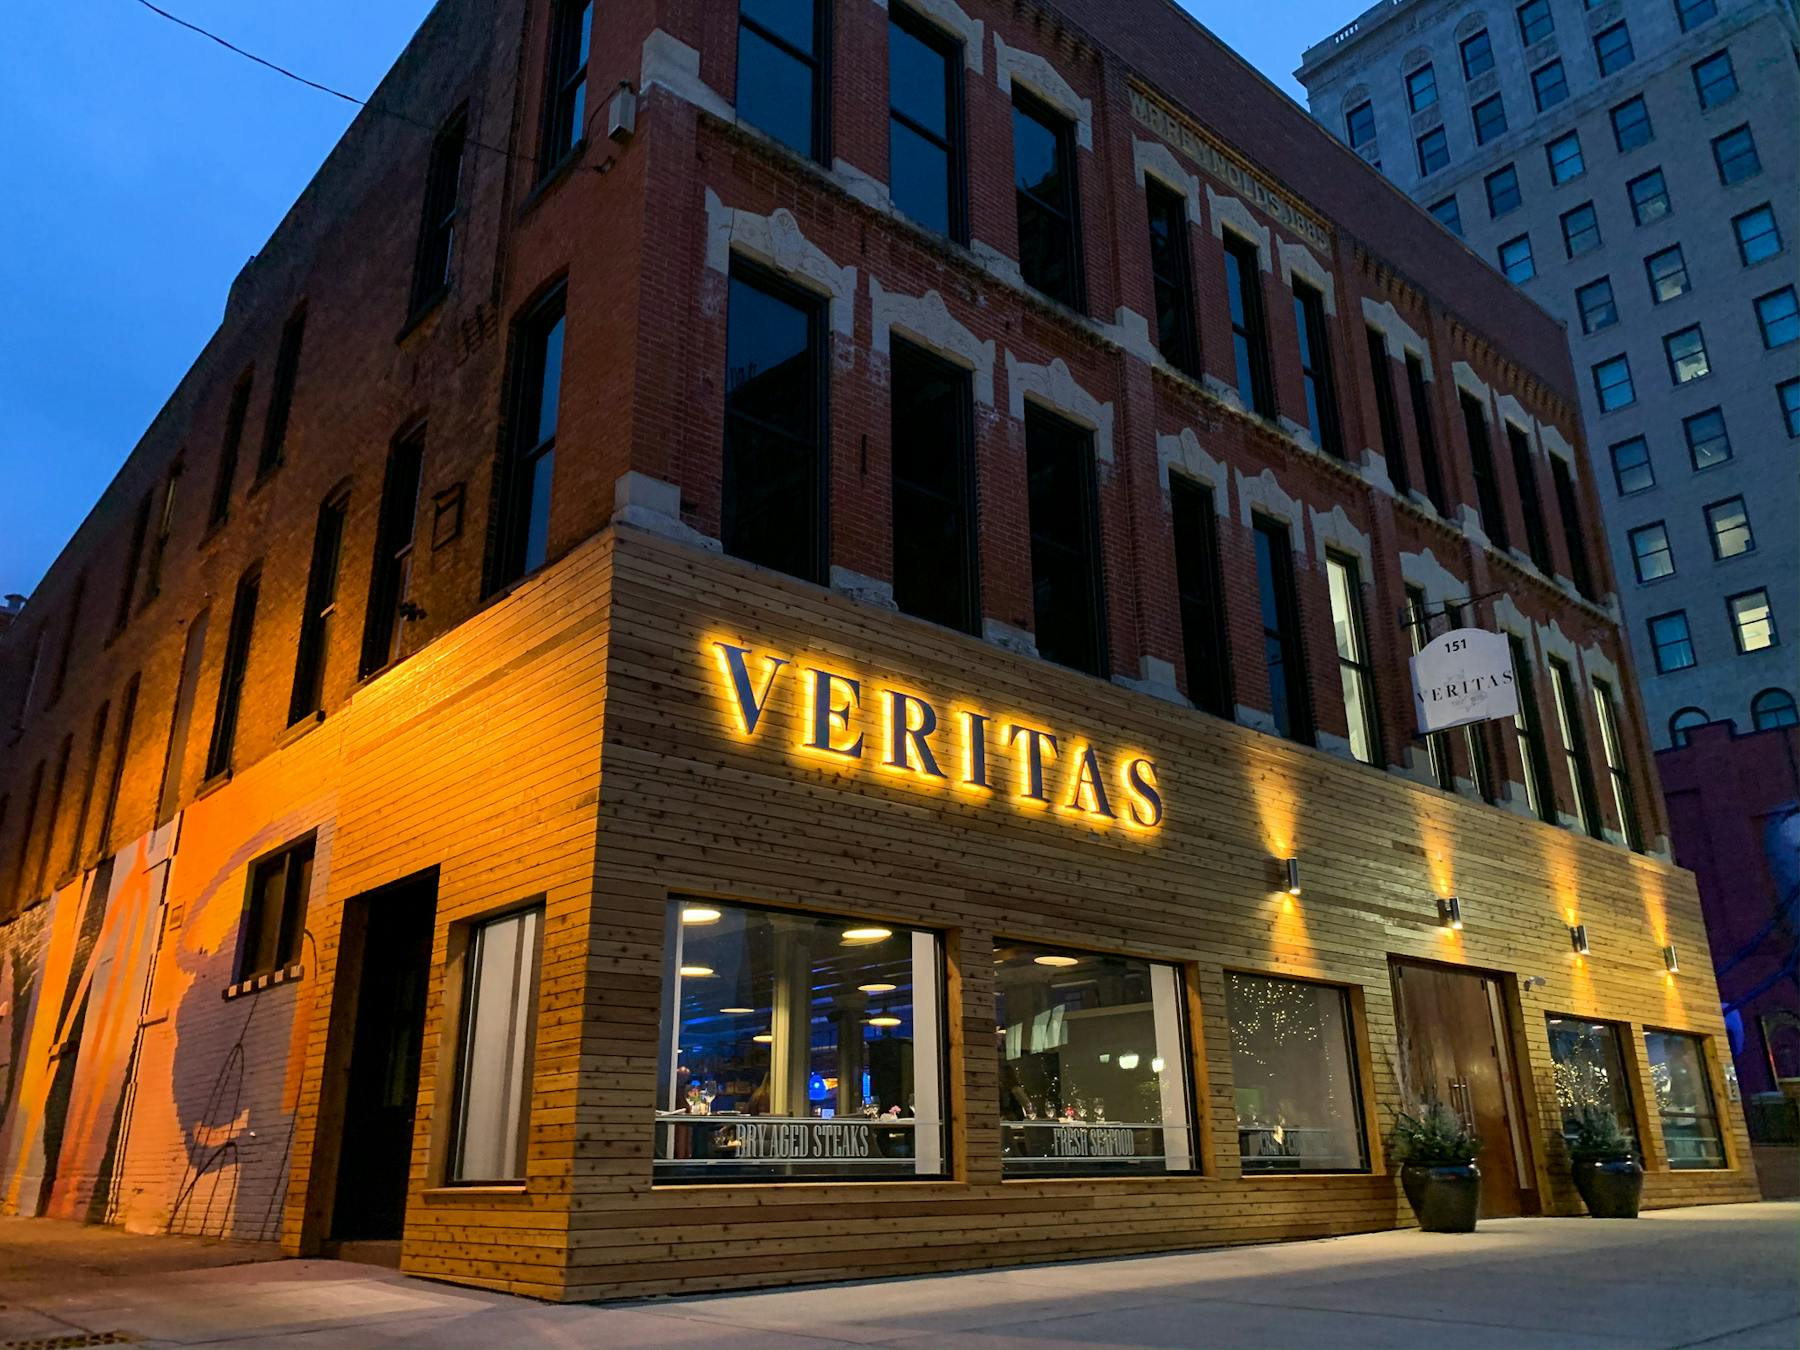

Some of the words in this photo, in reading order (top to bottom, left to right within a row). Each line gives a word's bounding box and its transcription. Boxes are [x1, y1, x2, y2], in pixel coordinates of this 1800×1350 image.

[1445, 639, 1467, 653] 151
[1417, 670, 1513, 704] VERITAS
[713, 641, 1163, 827] VERITAS
[735, 1124, 767, 1157] DRY
[770, 1124, 809, 1157] AGED
[813, 1124, 869, 1157] STEAKS
[1053, 1128, 1089, 1156] FRESH
[1090, 1128, 1135, 1156] SEAFOOD
